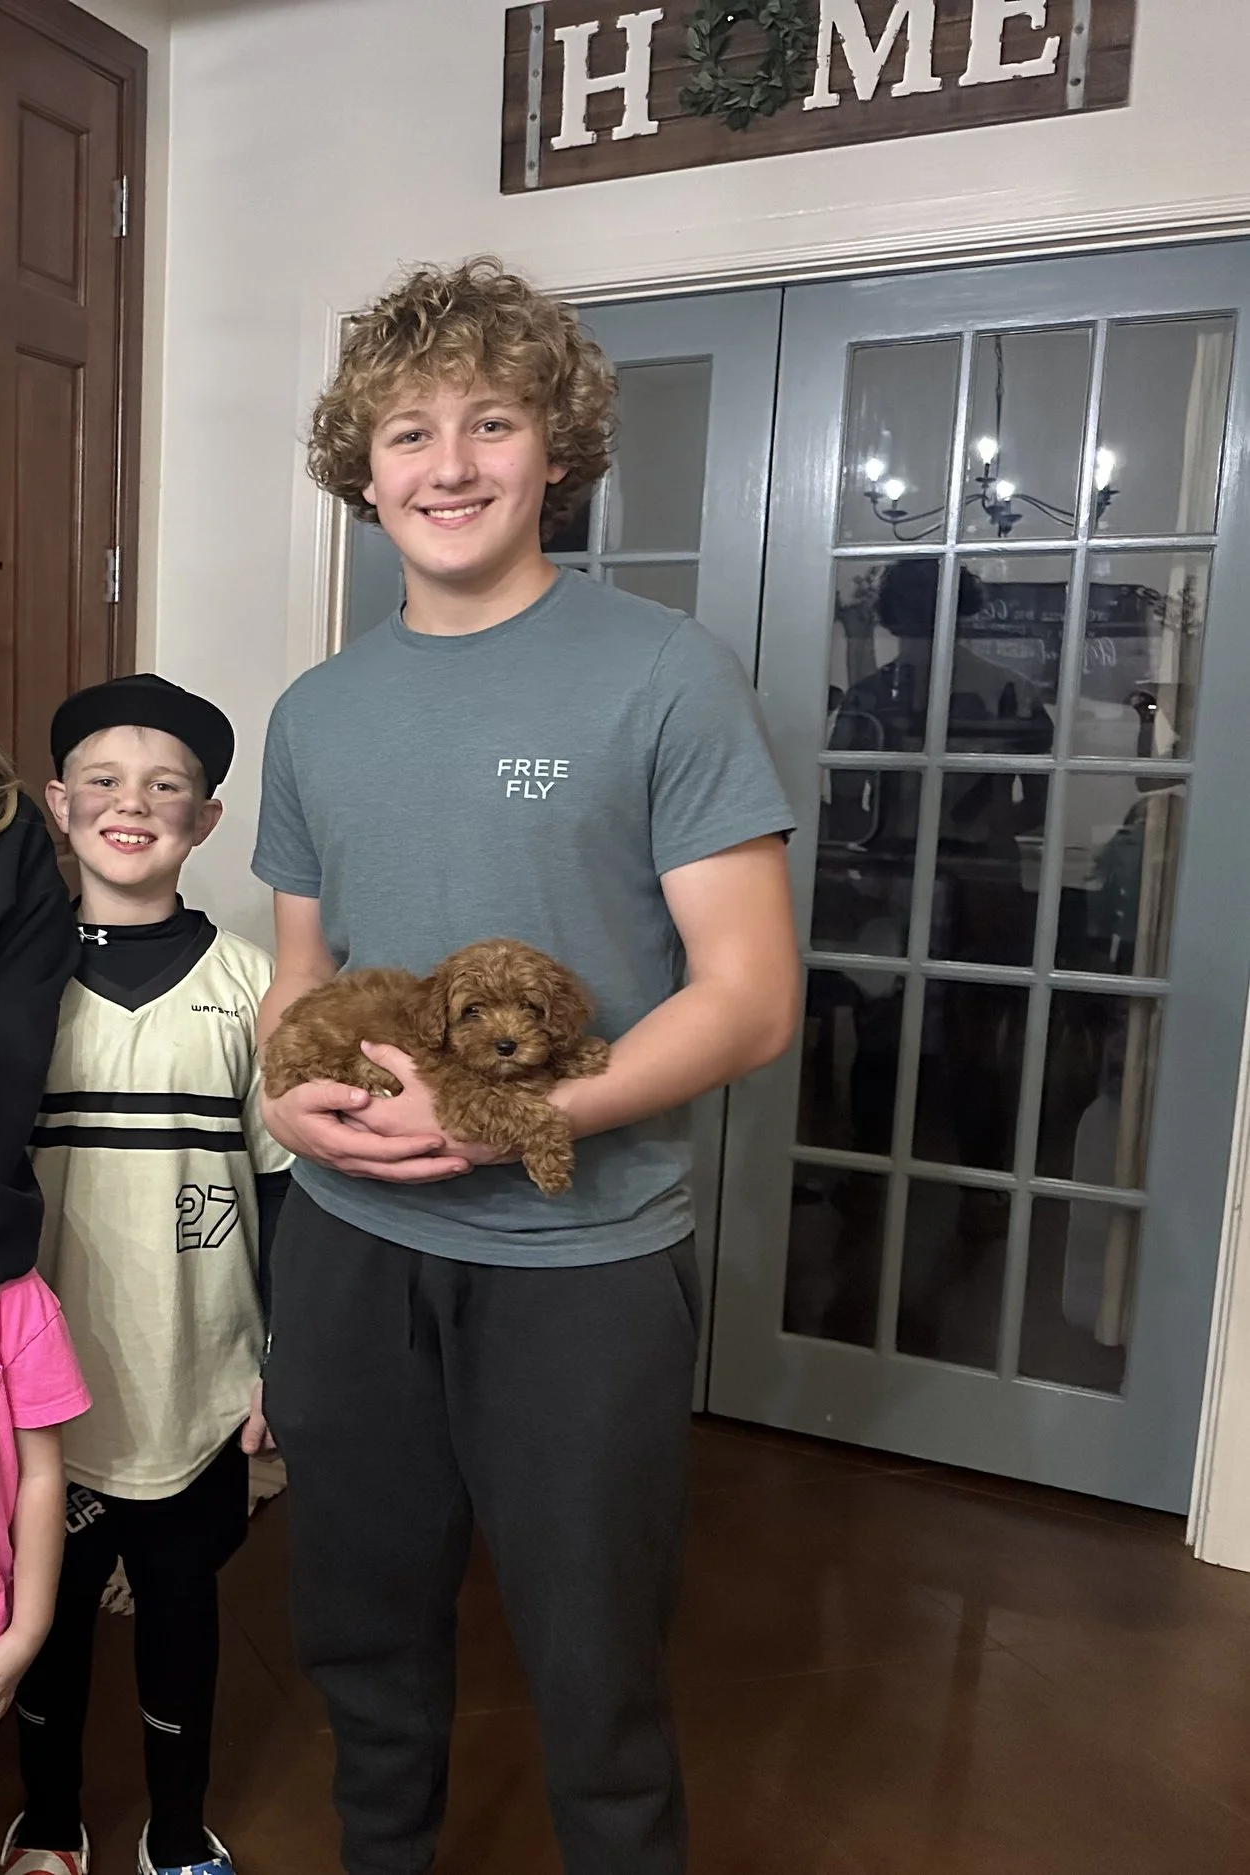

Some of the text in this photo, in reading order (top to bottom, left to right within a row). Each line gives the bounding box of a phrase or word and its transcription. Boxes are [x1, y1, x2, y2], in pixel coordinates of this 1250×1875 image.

[497, 758, 570, 778] FREE
[506, 779, 555, 800] FLY
[175, 1184, 239, 1253] 27
